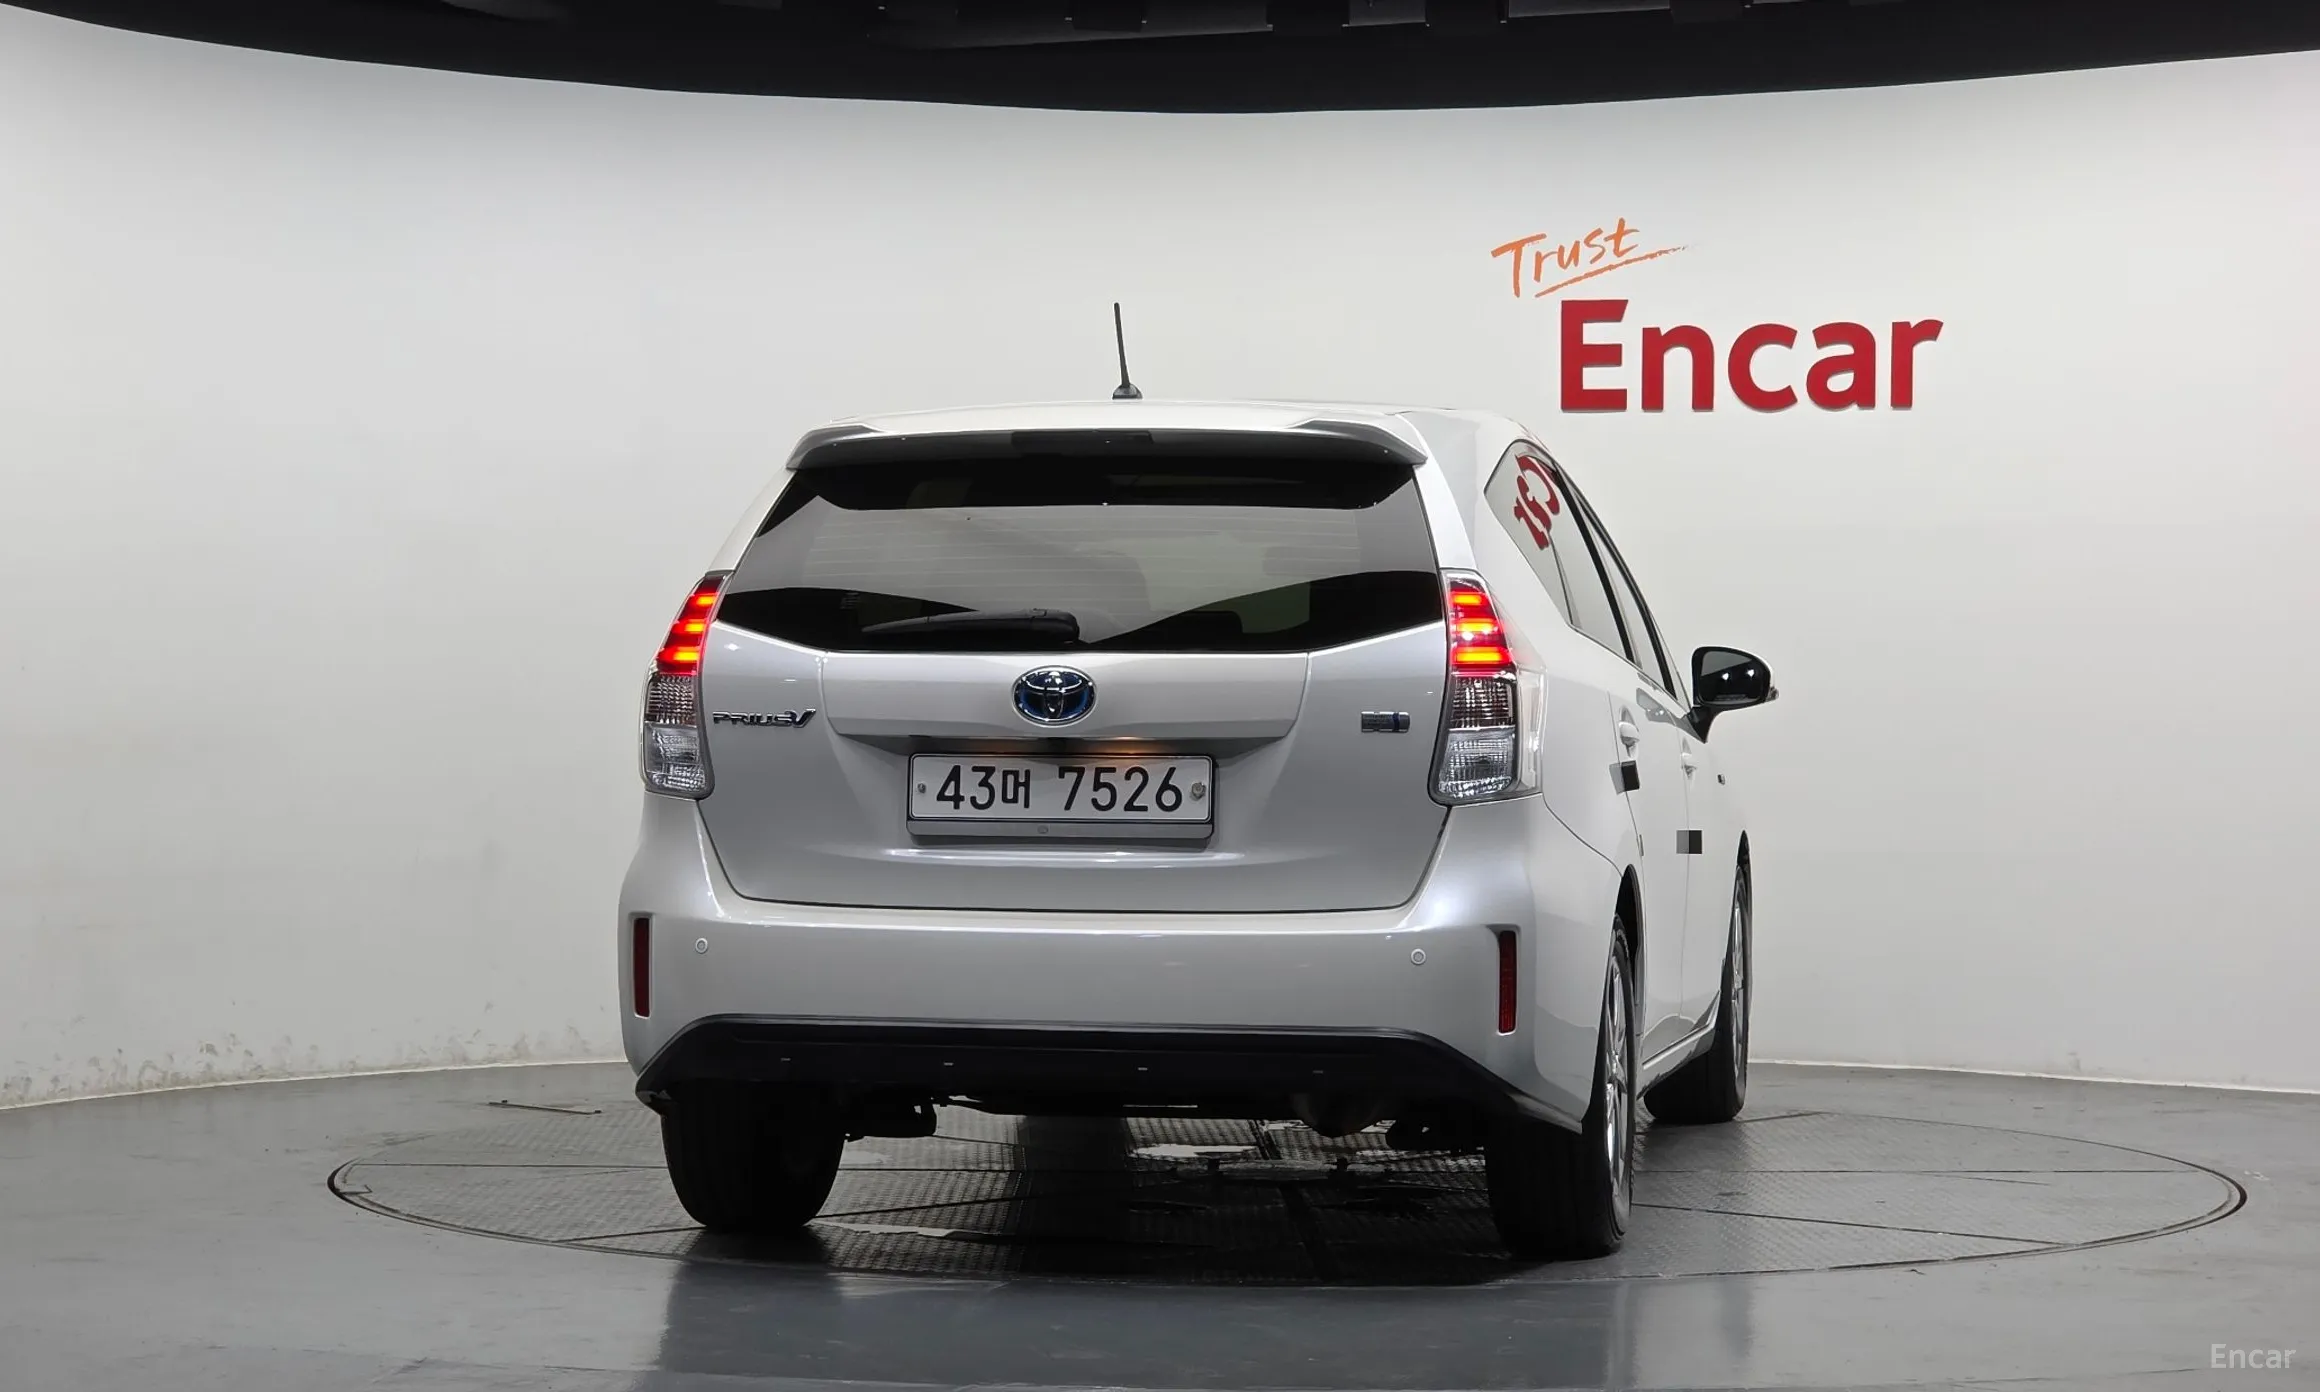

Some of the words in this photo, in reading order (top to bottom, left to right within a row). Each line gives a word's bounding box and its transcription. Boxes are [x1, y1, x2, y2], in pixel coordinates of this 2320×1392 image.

[1491, 217, 1640, 298] Trust
[1560, 299, 1944, 412] Encar
[936, 764, 1031, 811] 43머
[1058, 766, 1183, 812] 7526
